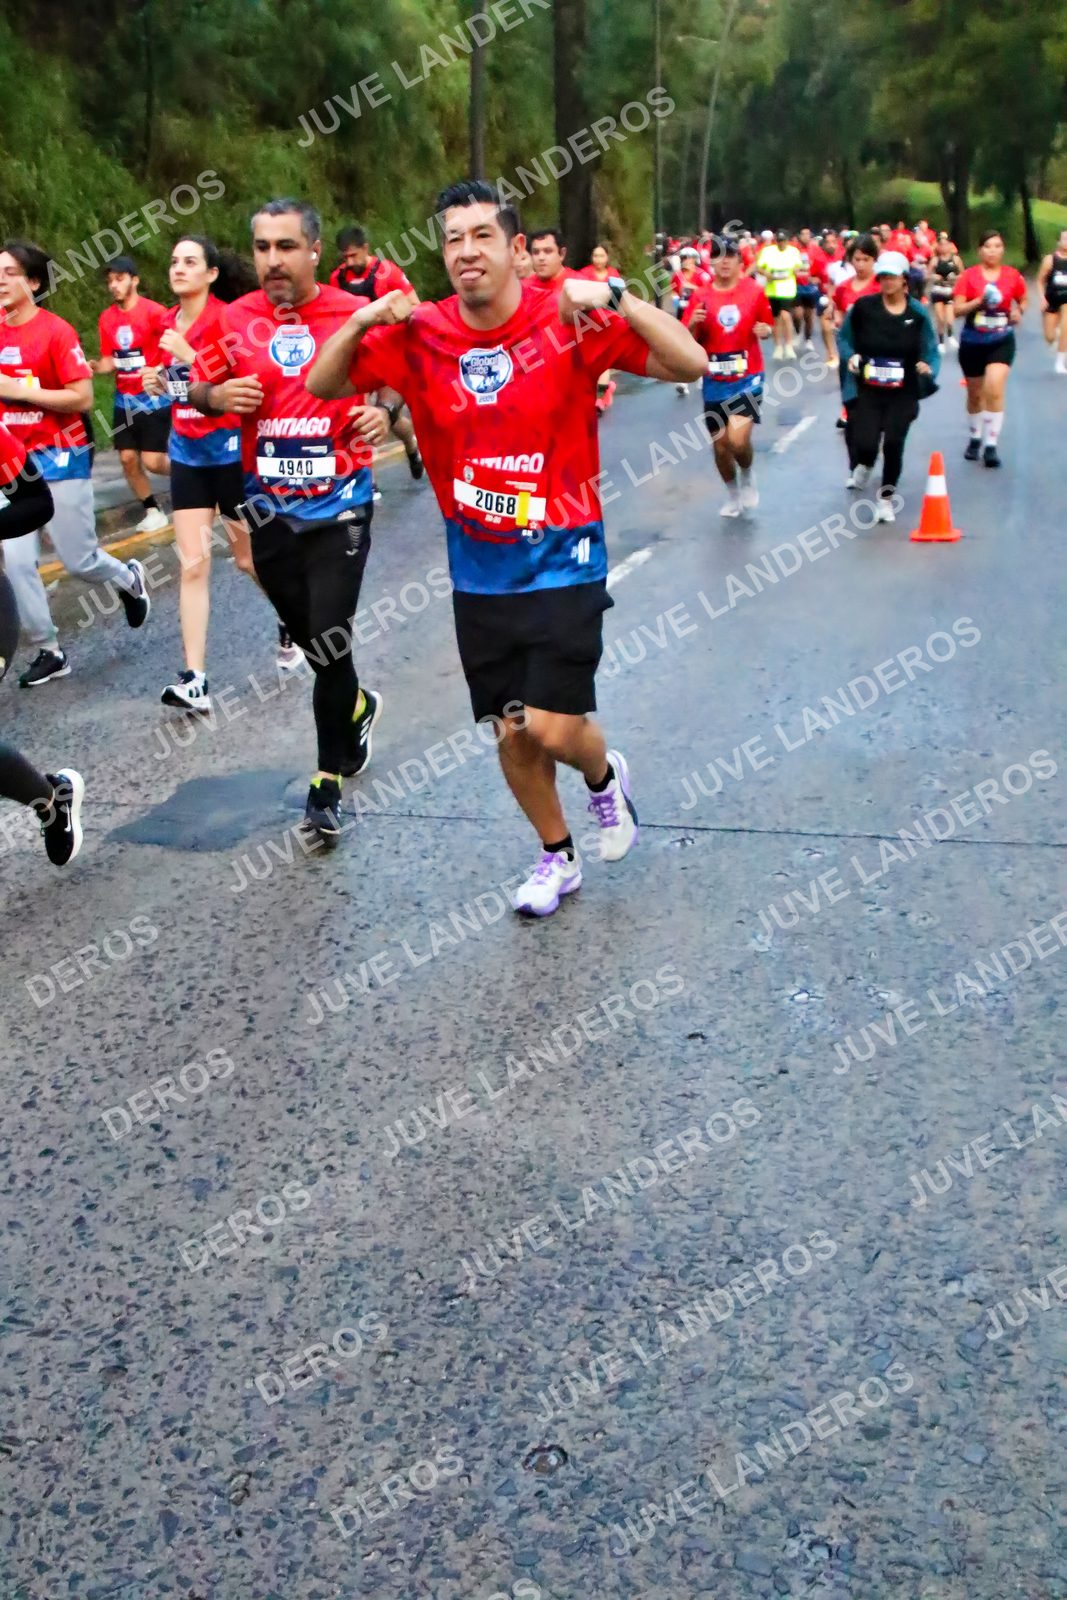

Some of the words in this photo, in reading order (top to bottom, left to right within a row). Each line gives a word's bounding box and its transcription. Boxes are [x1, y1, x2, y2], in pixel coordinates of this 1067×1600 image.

[256, 416, 331, 437] SANTIAGO
[278, 459, 313, 476] 4940
[465, 453, 545, 474] TIAGO
[475, 489, 517, 516] 2068
